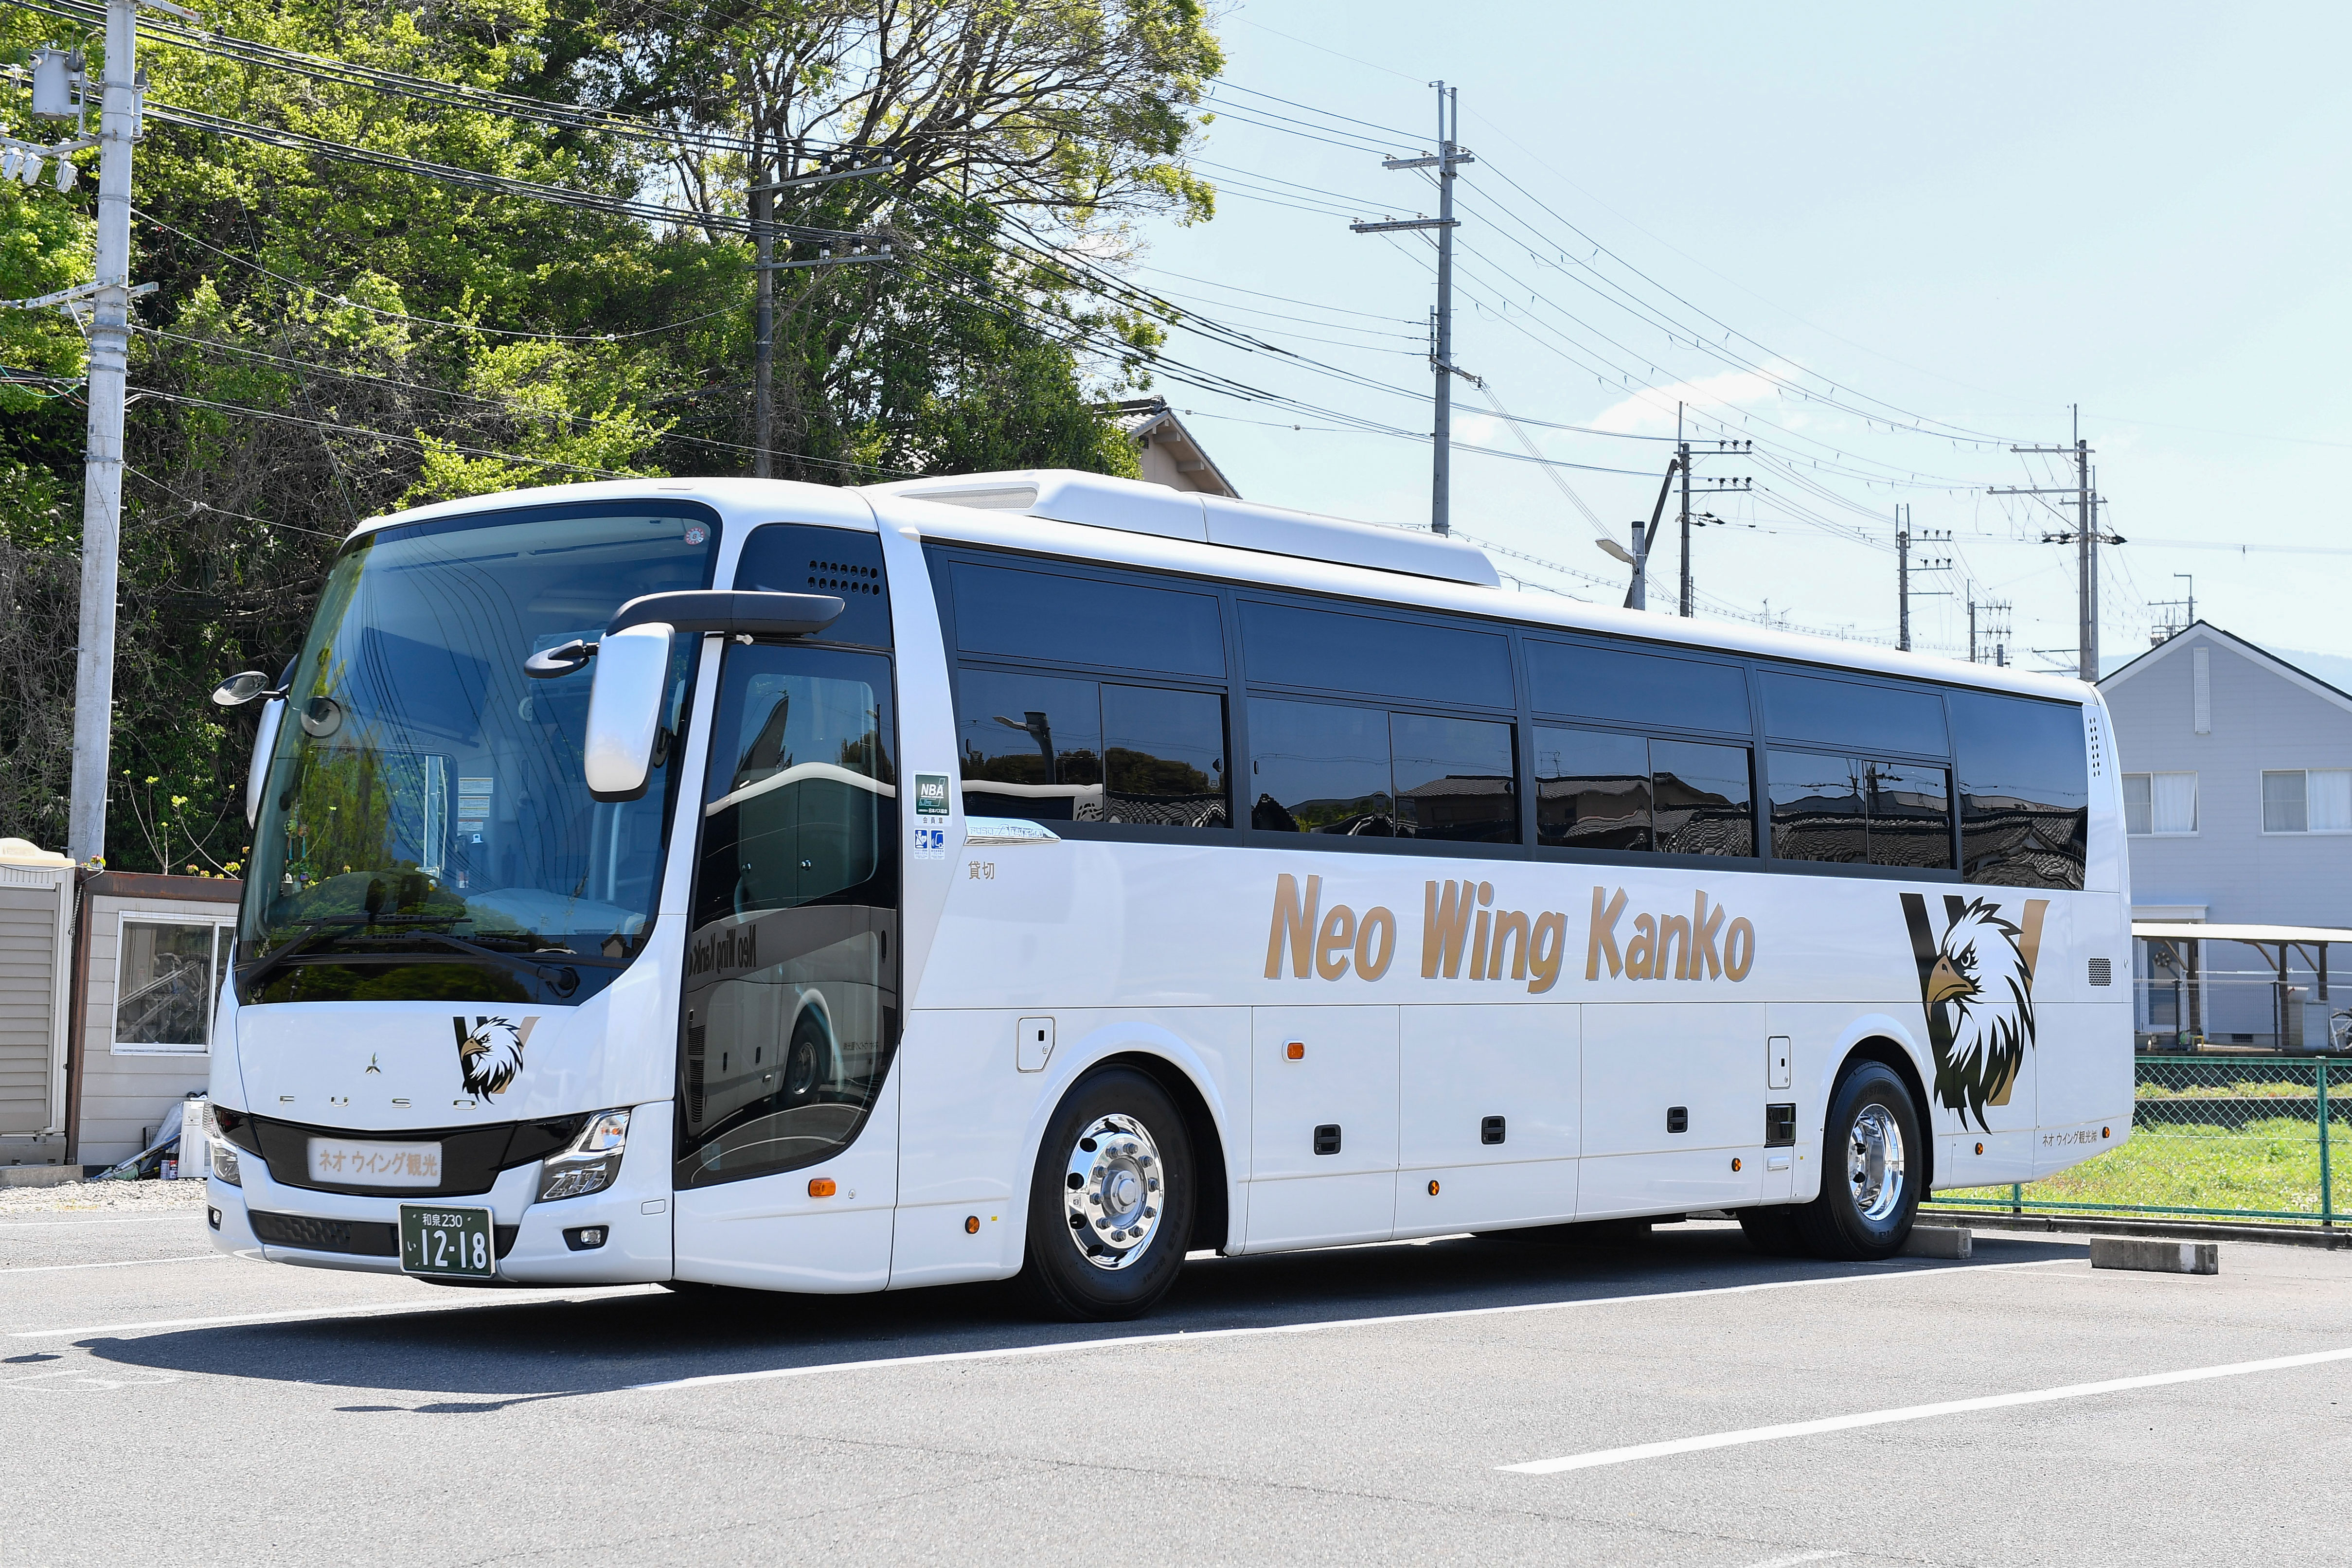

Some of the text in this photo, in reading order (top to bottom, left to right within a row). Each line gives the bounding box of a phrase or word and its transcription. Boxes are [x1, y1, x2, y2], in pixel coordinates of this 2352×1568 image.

[921, 784, 944, 796] NBA
[968, 861, 995, 880] 貸切
[1264, 873, 1755, 995] Neo Wing Kanko
[279, 1095, 477, 1110] FUSO
[408, 1229, 486, 1269] い 12-18
